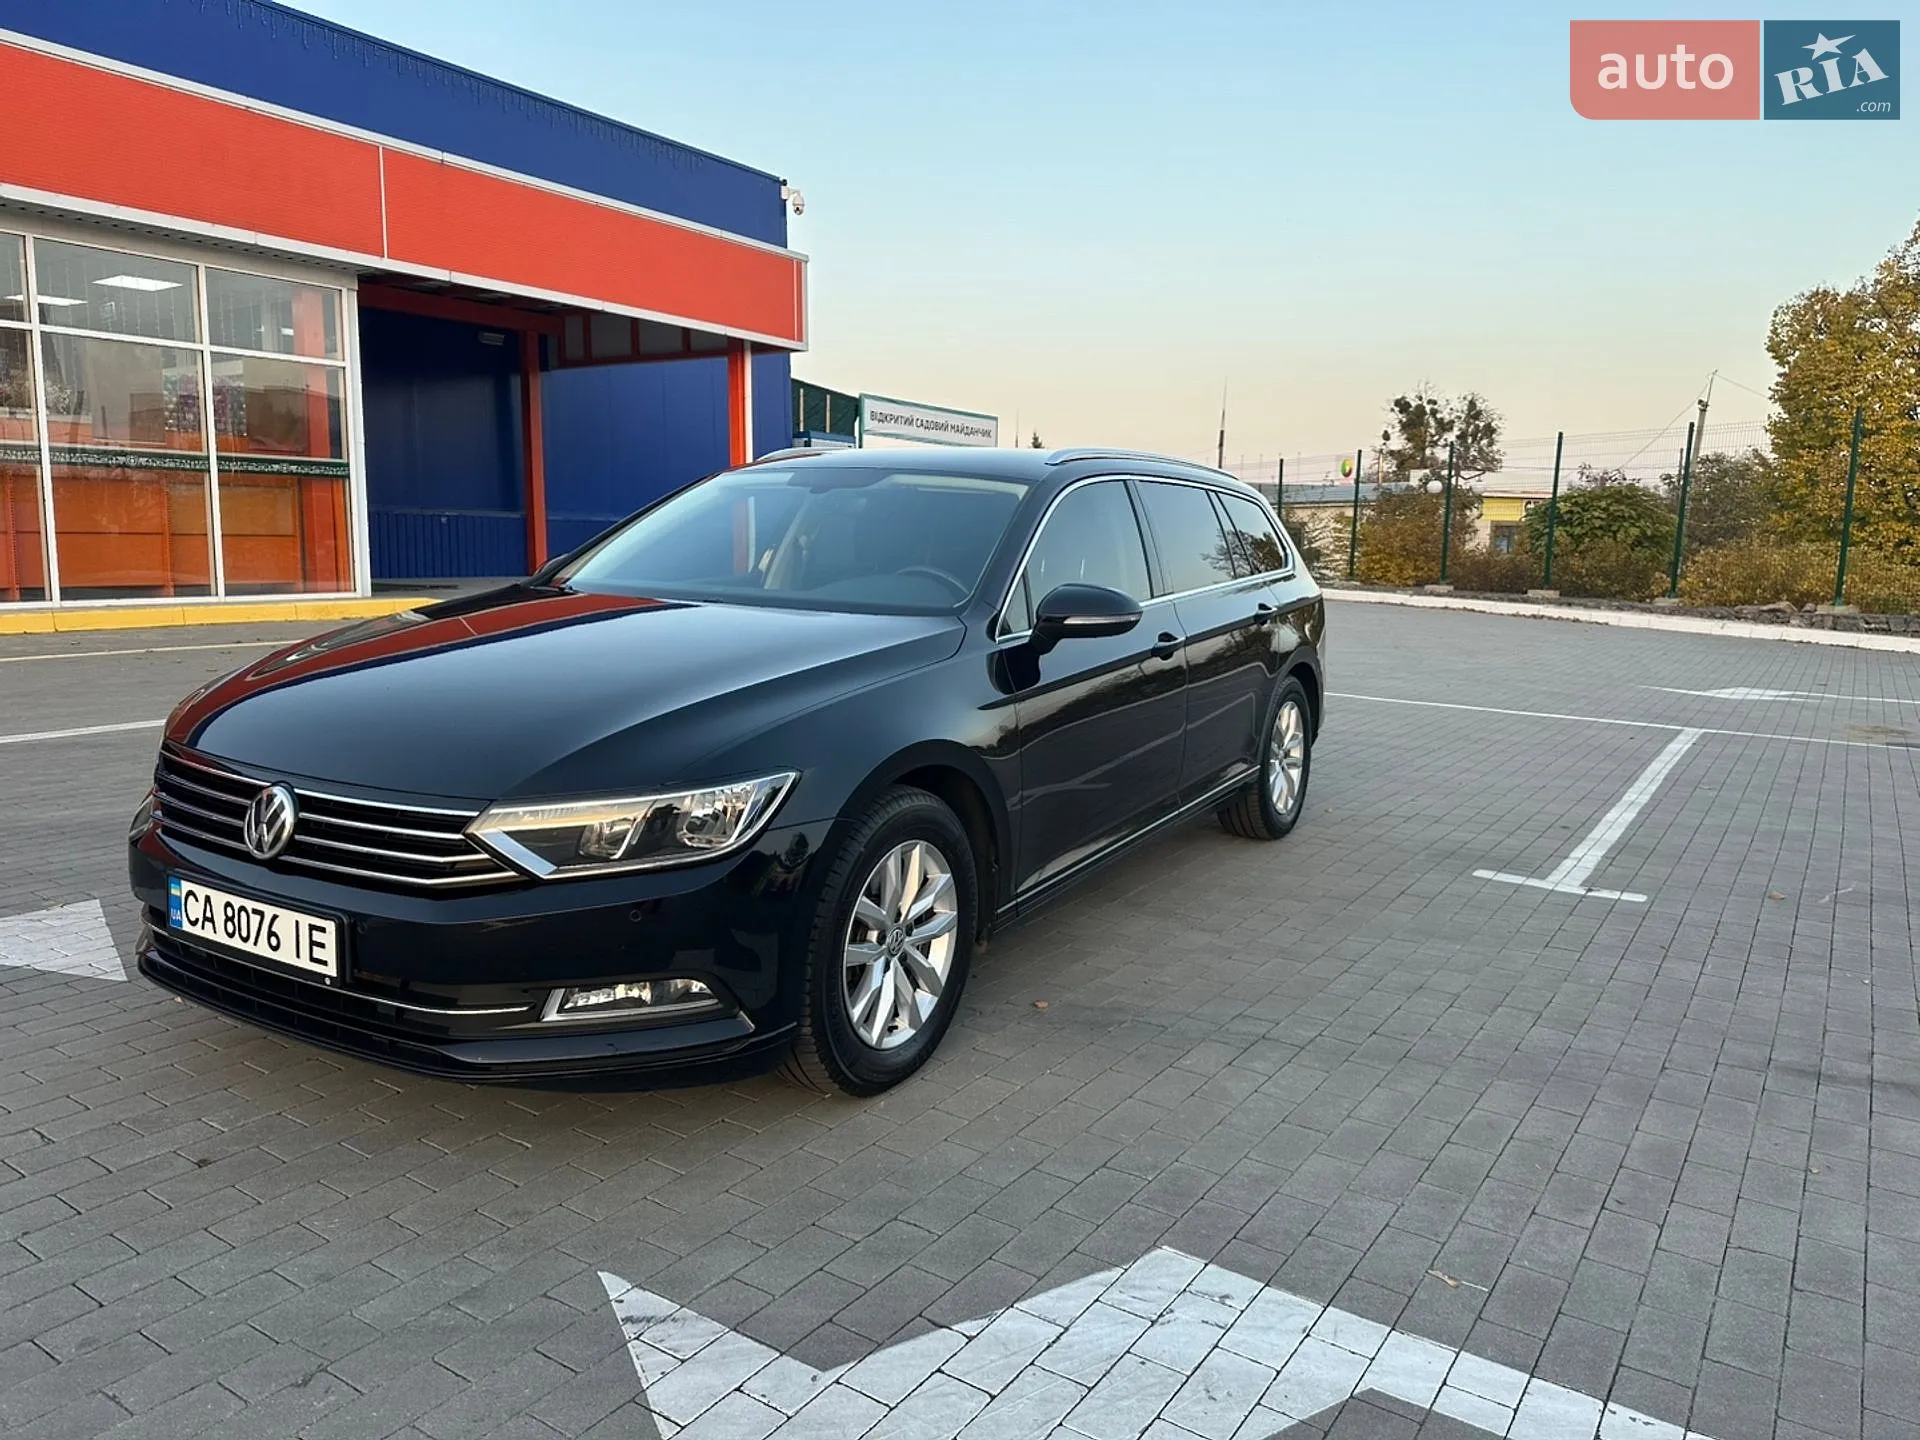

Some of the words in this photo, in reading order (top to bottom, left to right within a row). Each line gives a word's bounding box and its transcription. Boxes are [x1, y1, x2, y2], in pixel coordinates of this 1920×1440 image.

[870, 411, 914, 427] ВІДКРИТИЙ
[915, 418, 948, 431] САДОВИЙ
[950, 423, 992, 438] МАЙДАНЧИК
[170, 908, 182, 920] UA
[184, 890, 217, 934] CA
[223, 901, 281, 952] 8076
[295, 919, 328, 966] IE
